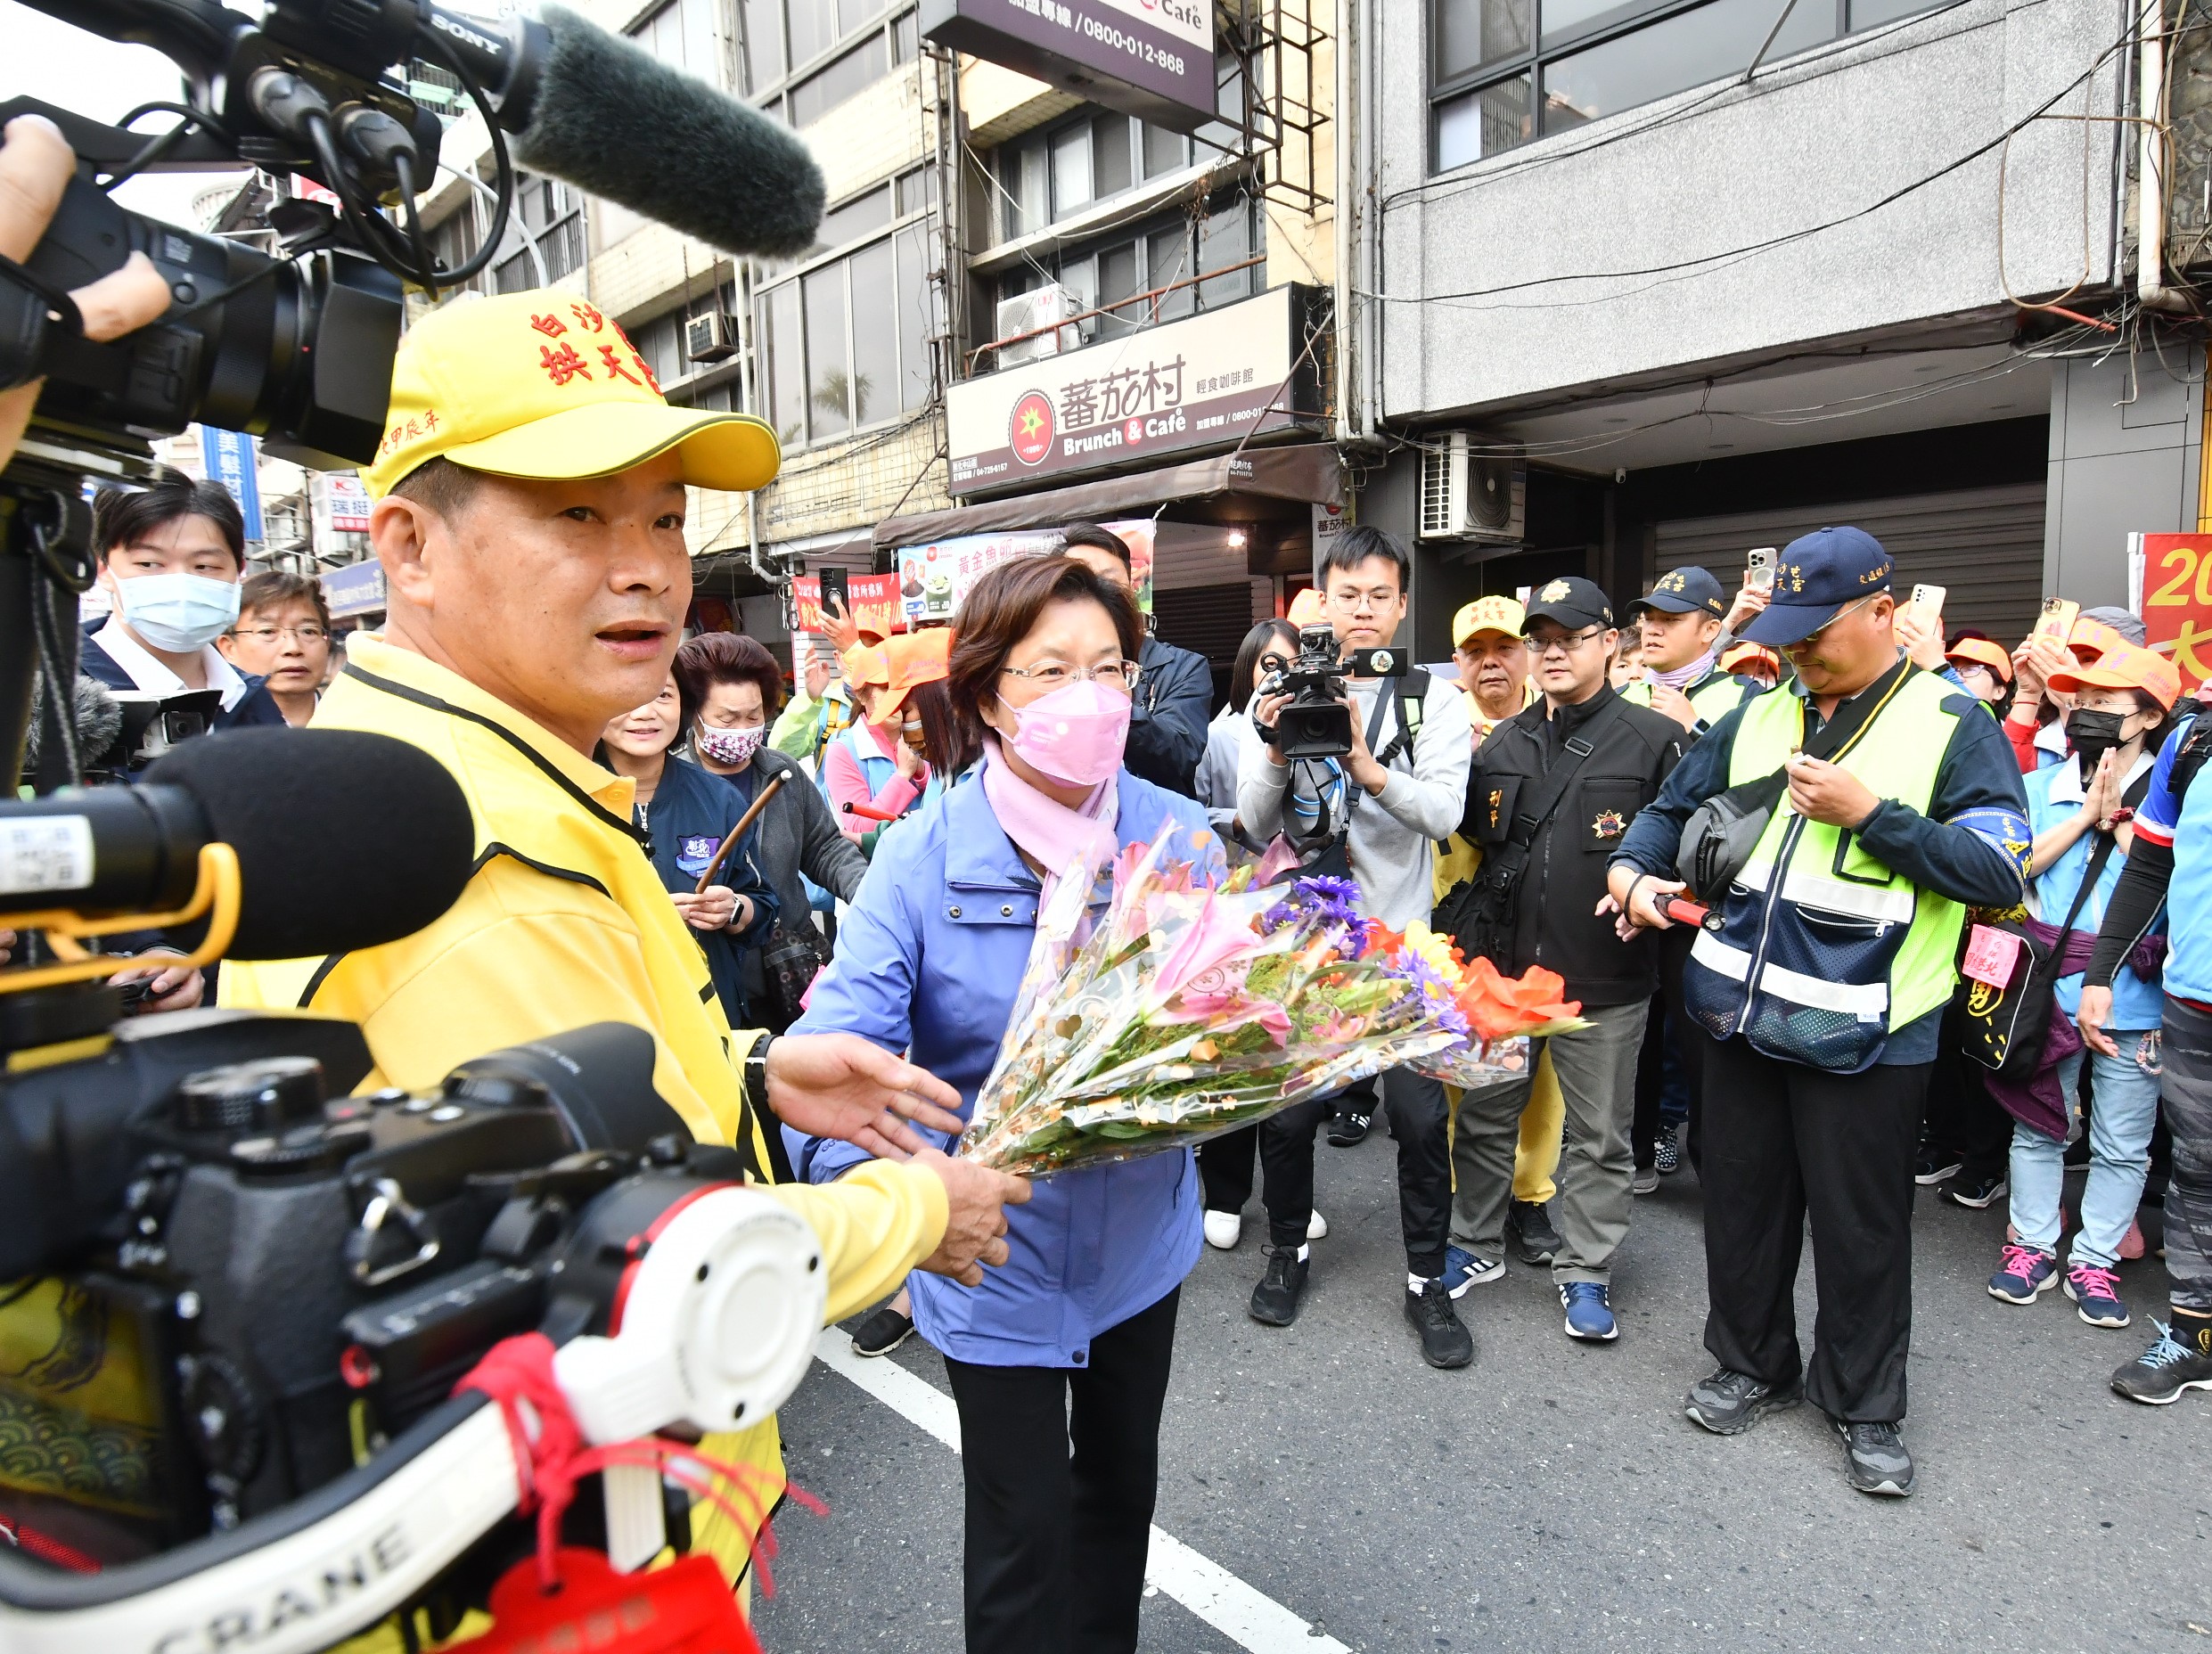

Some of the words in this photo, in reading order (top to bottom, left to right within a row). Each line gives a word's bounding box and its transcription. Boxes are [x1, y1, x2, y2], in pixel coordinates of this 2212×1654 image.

[431, 12, 502, 54] SONY
[1084, 16, 1185, 76] 0800-012-868
[1060, 353, 1186, 430] 蕃茄村
[1196, 368, 1254, 395] 輕食咖啡館
[1063, 427, 1122, 456] Brunch
[1126, 420, 1143, 441] &
